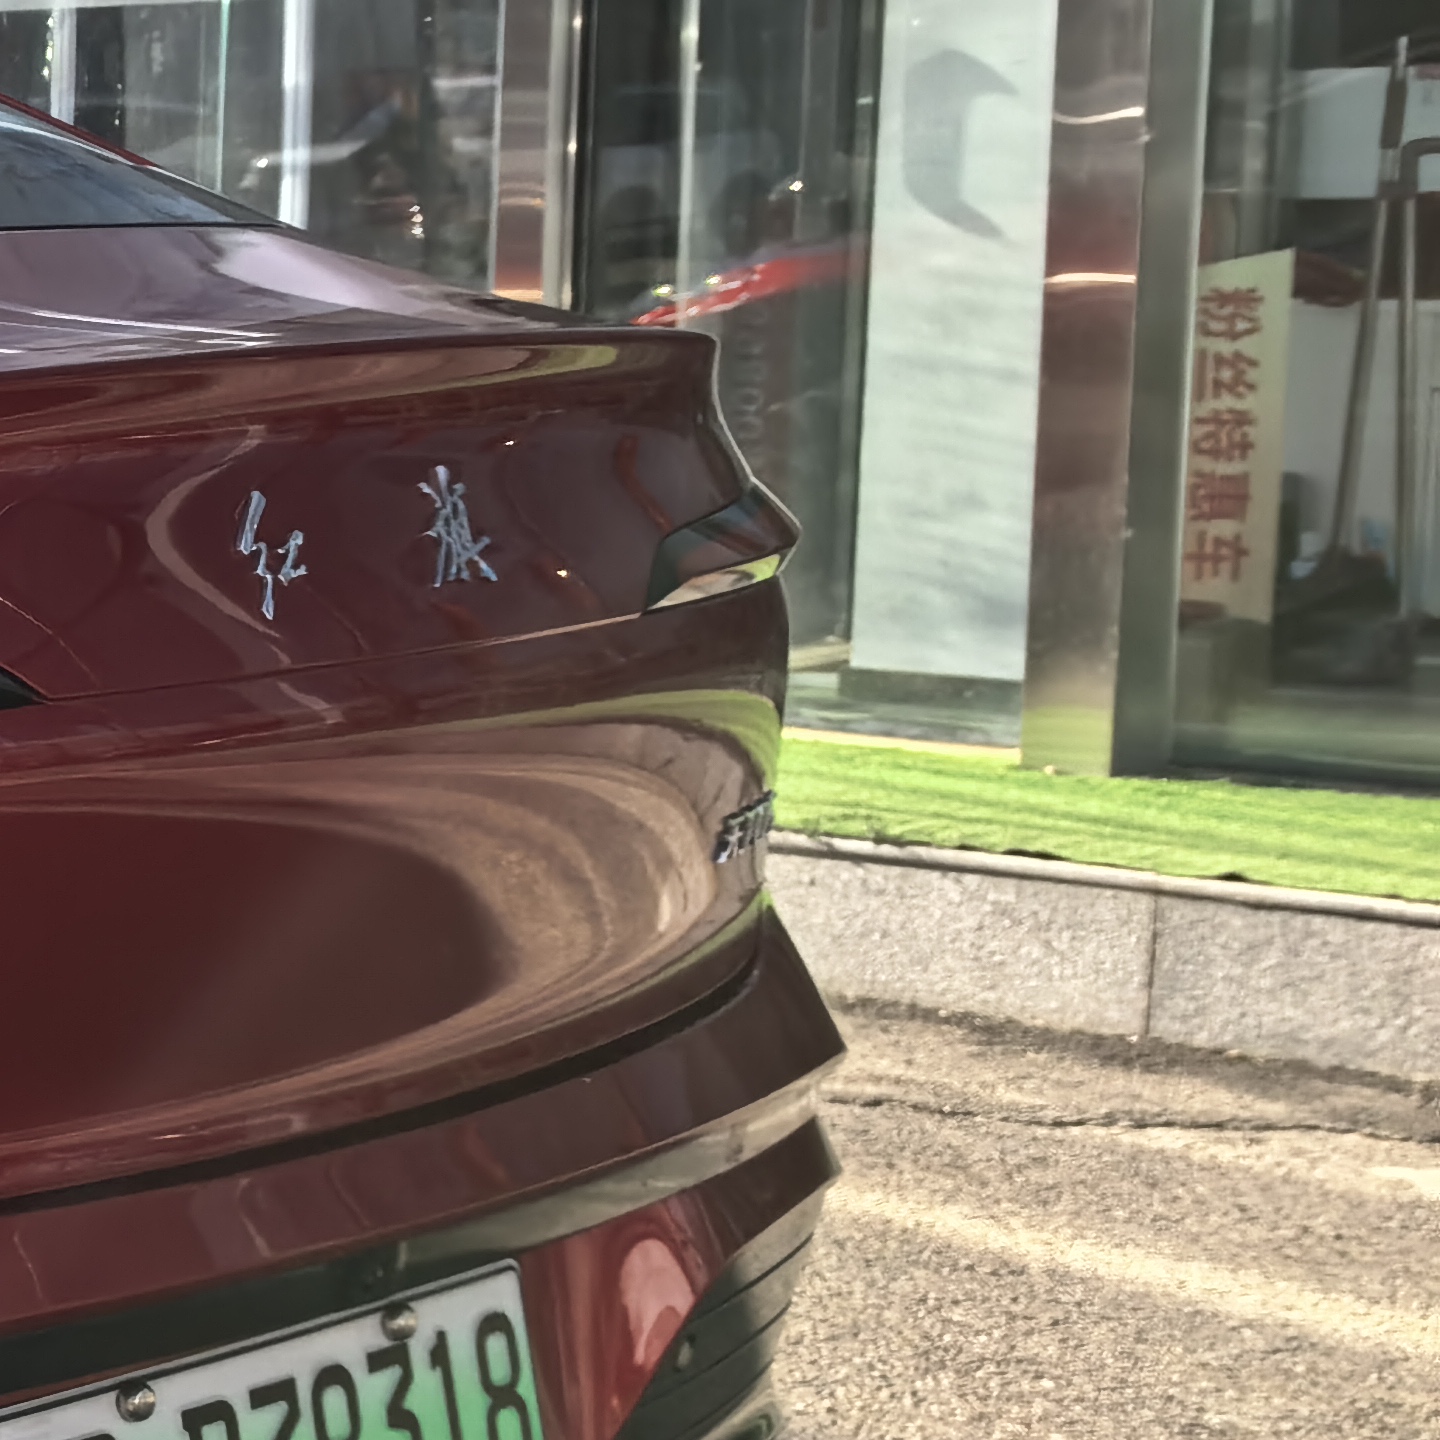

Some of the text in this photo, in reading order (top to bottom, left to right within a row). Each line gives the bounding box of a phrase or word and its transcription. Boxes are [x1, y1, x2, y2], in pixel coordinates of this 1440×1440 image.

[235, 465, 499, 621] 红旗
[1183, 286, 1265, 583] 粉丝特惠车
